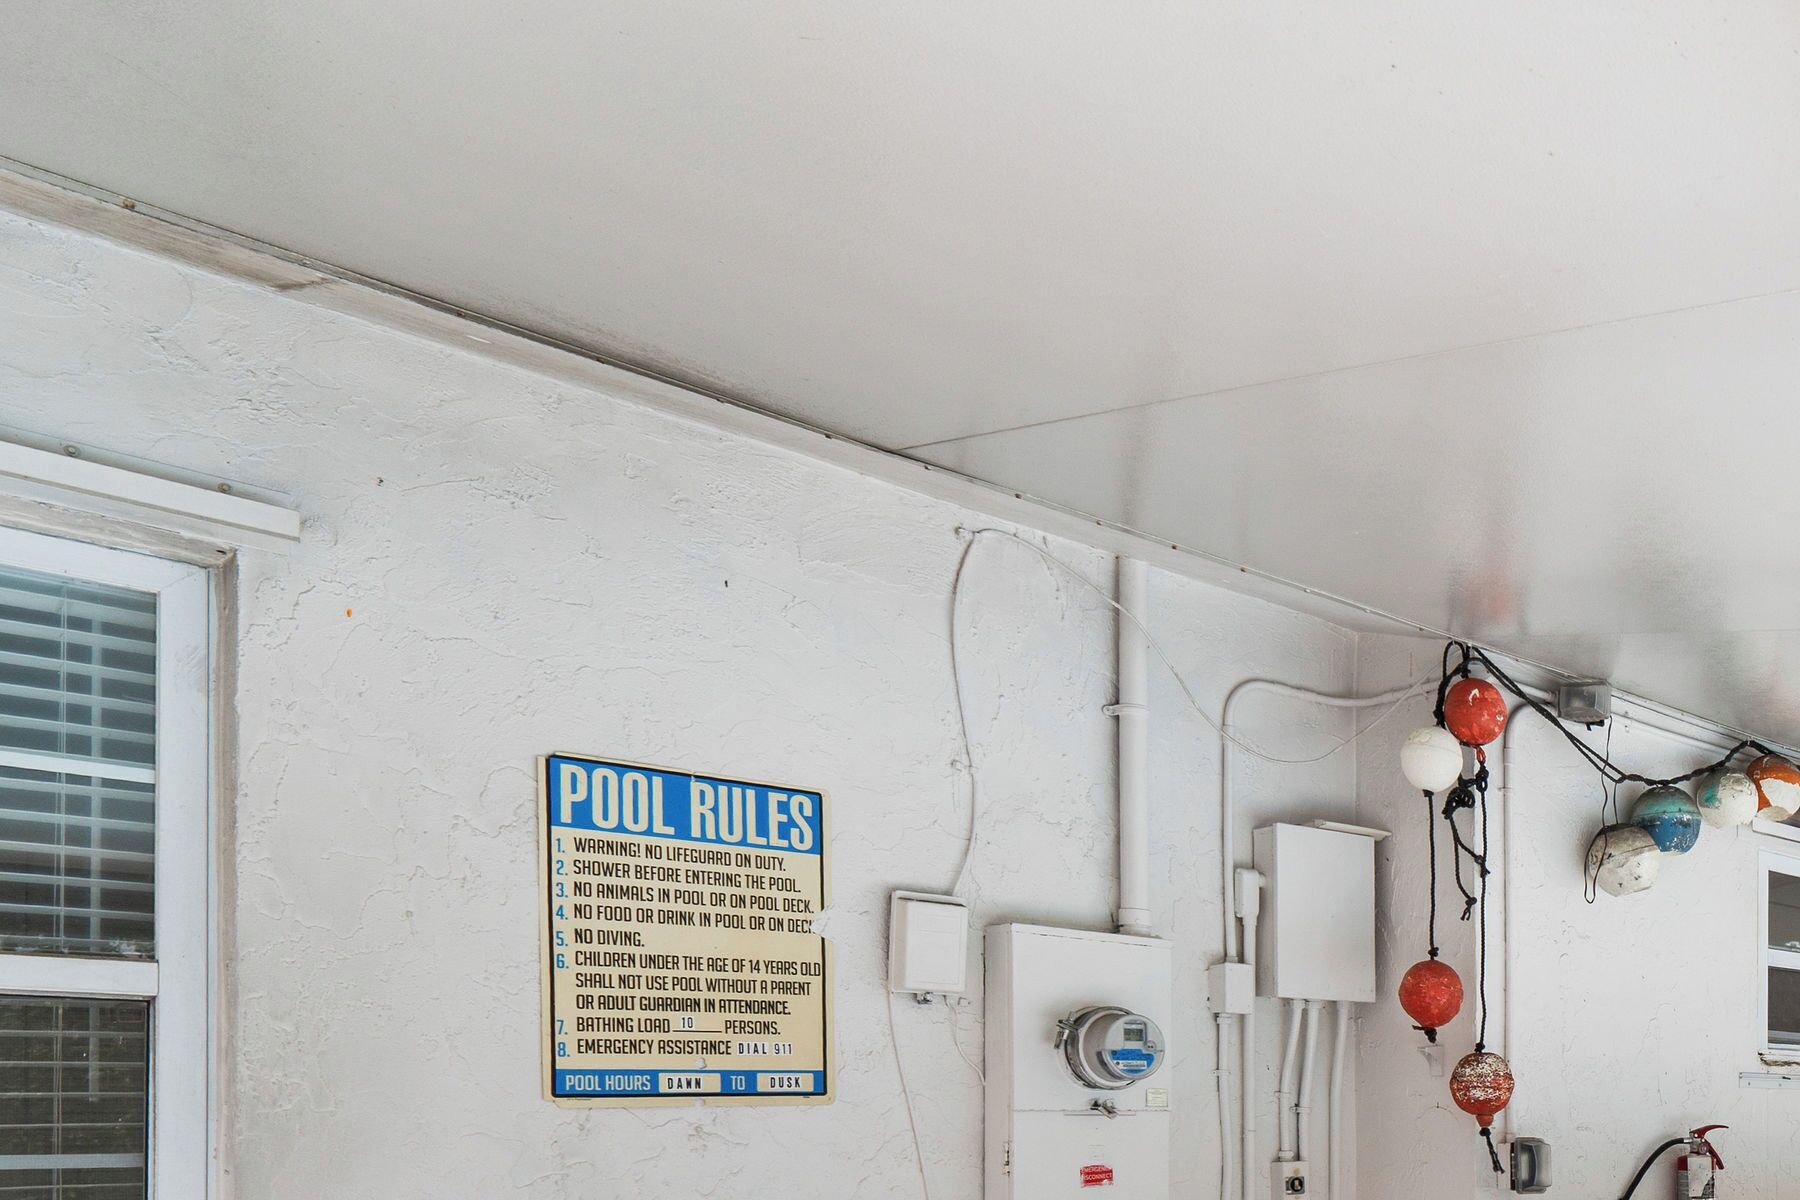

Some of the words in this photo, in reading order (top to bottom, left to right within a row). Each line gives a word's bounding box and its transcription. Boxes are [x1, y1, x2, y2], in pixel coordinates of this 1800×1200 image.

[560, 763, 675, 835] POOL
[690, 782, 813, 850] RULES
[555, 837, 566, 854] 1.
[573, 836, 641, 858] WARNING!
[645, 844, 663, 860] NO
[666, 846, 732, 867] LIFEGUARD
[735, 852, 752, 869] ON
[755, 854, 786, 872] DUTY.
[555, 858, 568, 877] 2.
[573, 859, 631, 879] SHOWER
[634, 864, 682, 883] BEFORE
[685, 869, 742, 888] ENTERING
[744, 874, 766, 890] THE
[769, 876, 801, 893] POOL.
[555, 881, 568, 898] 3.
[573, 881, 592, 898] NO
[596, 883, 654, 902] ANIMALS
[658, 887, 671, 904] IN
[674, 889, 707, 906] POOL
[709, 892, 727, 908] OR
[729, 893, 746, 909] ON
[750, 894, 780, 912] POOL
[783, 897, 815, 914] DECK.
[555, 904, 568, 920] 4.
[574, 903, 593, 920] NO
[596, 905, 632, 922] FOOD
[636, 907, 654, 924] OR
[657, 909, 696, 927] DRINK
[699, 912, 711, 928] IN
[715, 913, 746, 930] POOL
[749, 915, 765, 931] OR
[768, 916, 784, 932] ON
[556, 929, 568, 948] 5.
[574, 927, 593, 945] NO
[597, 929, 645, 948] DIVING.
[556, 952, 569, 970] 6.
[575, 950, 636, 969] CHILDREN
[639, 953, 680, 970] UNDER
[682, 955, 704, 972] THE
[706, 957, 729, 973] AGE
[731, 958, 746, 973] OF
[748, 959, 761, 974] 14
[763, 959, 798, 976] YEARS
[800, 961, 821, 977] OLD
[575, 972, 616, 989] SHALL
[618, 974, 643, 990] NOT
[645, 975, 669, 991] USE
[671, 976, 703, 992] POOL
[705, 977, 758, 994] WITHOUT
[760, 979, 768, 995] A
[770, 980, 812, 996] PARENT
[576, 994, 595, 1010] OR
[598, 994, 637, 1011] ADULT
[639, 996, 701, 1013] GUARDIAN
[704, 998, 716, 1013] IN
[718, 998, 792, 1015] ATTENDANCE.
[556, 1019, 568, 1035] 7.
[576, 1016, 634, 1033] BATHING
[637, 1017, 671, 1034] LOAD
[681, 1016, 693, 1029] 10
[724, 1019, 781, 1035] PERSONS.
[557, 1041, 570, 1058] 8.
[577, 1038, 654, 1055] EMERGENCY
[658, 1039, 732, 1056] ASSISTANCE
[738, 1042, 767, 1055] DIAL
[774, 1043, 792, 1055] 911
[566, 1075, 601, 1091] POOL
[605, 1075, 651, 1090] HOURS
[667, 1077, 701, 1090] DAWN
[731, 1075, 745, 1090] TO
[770, 1076, 801, 1089] DUSK
